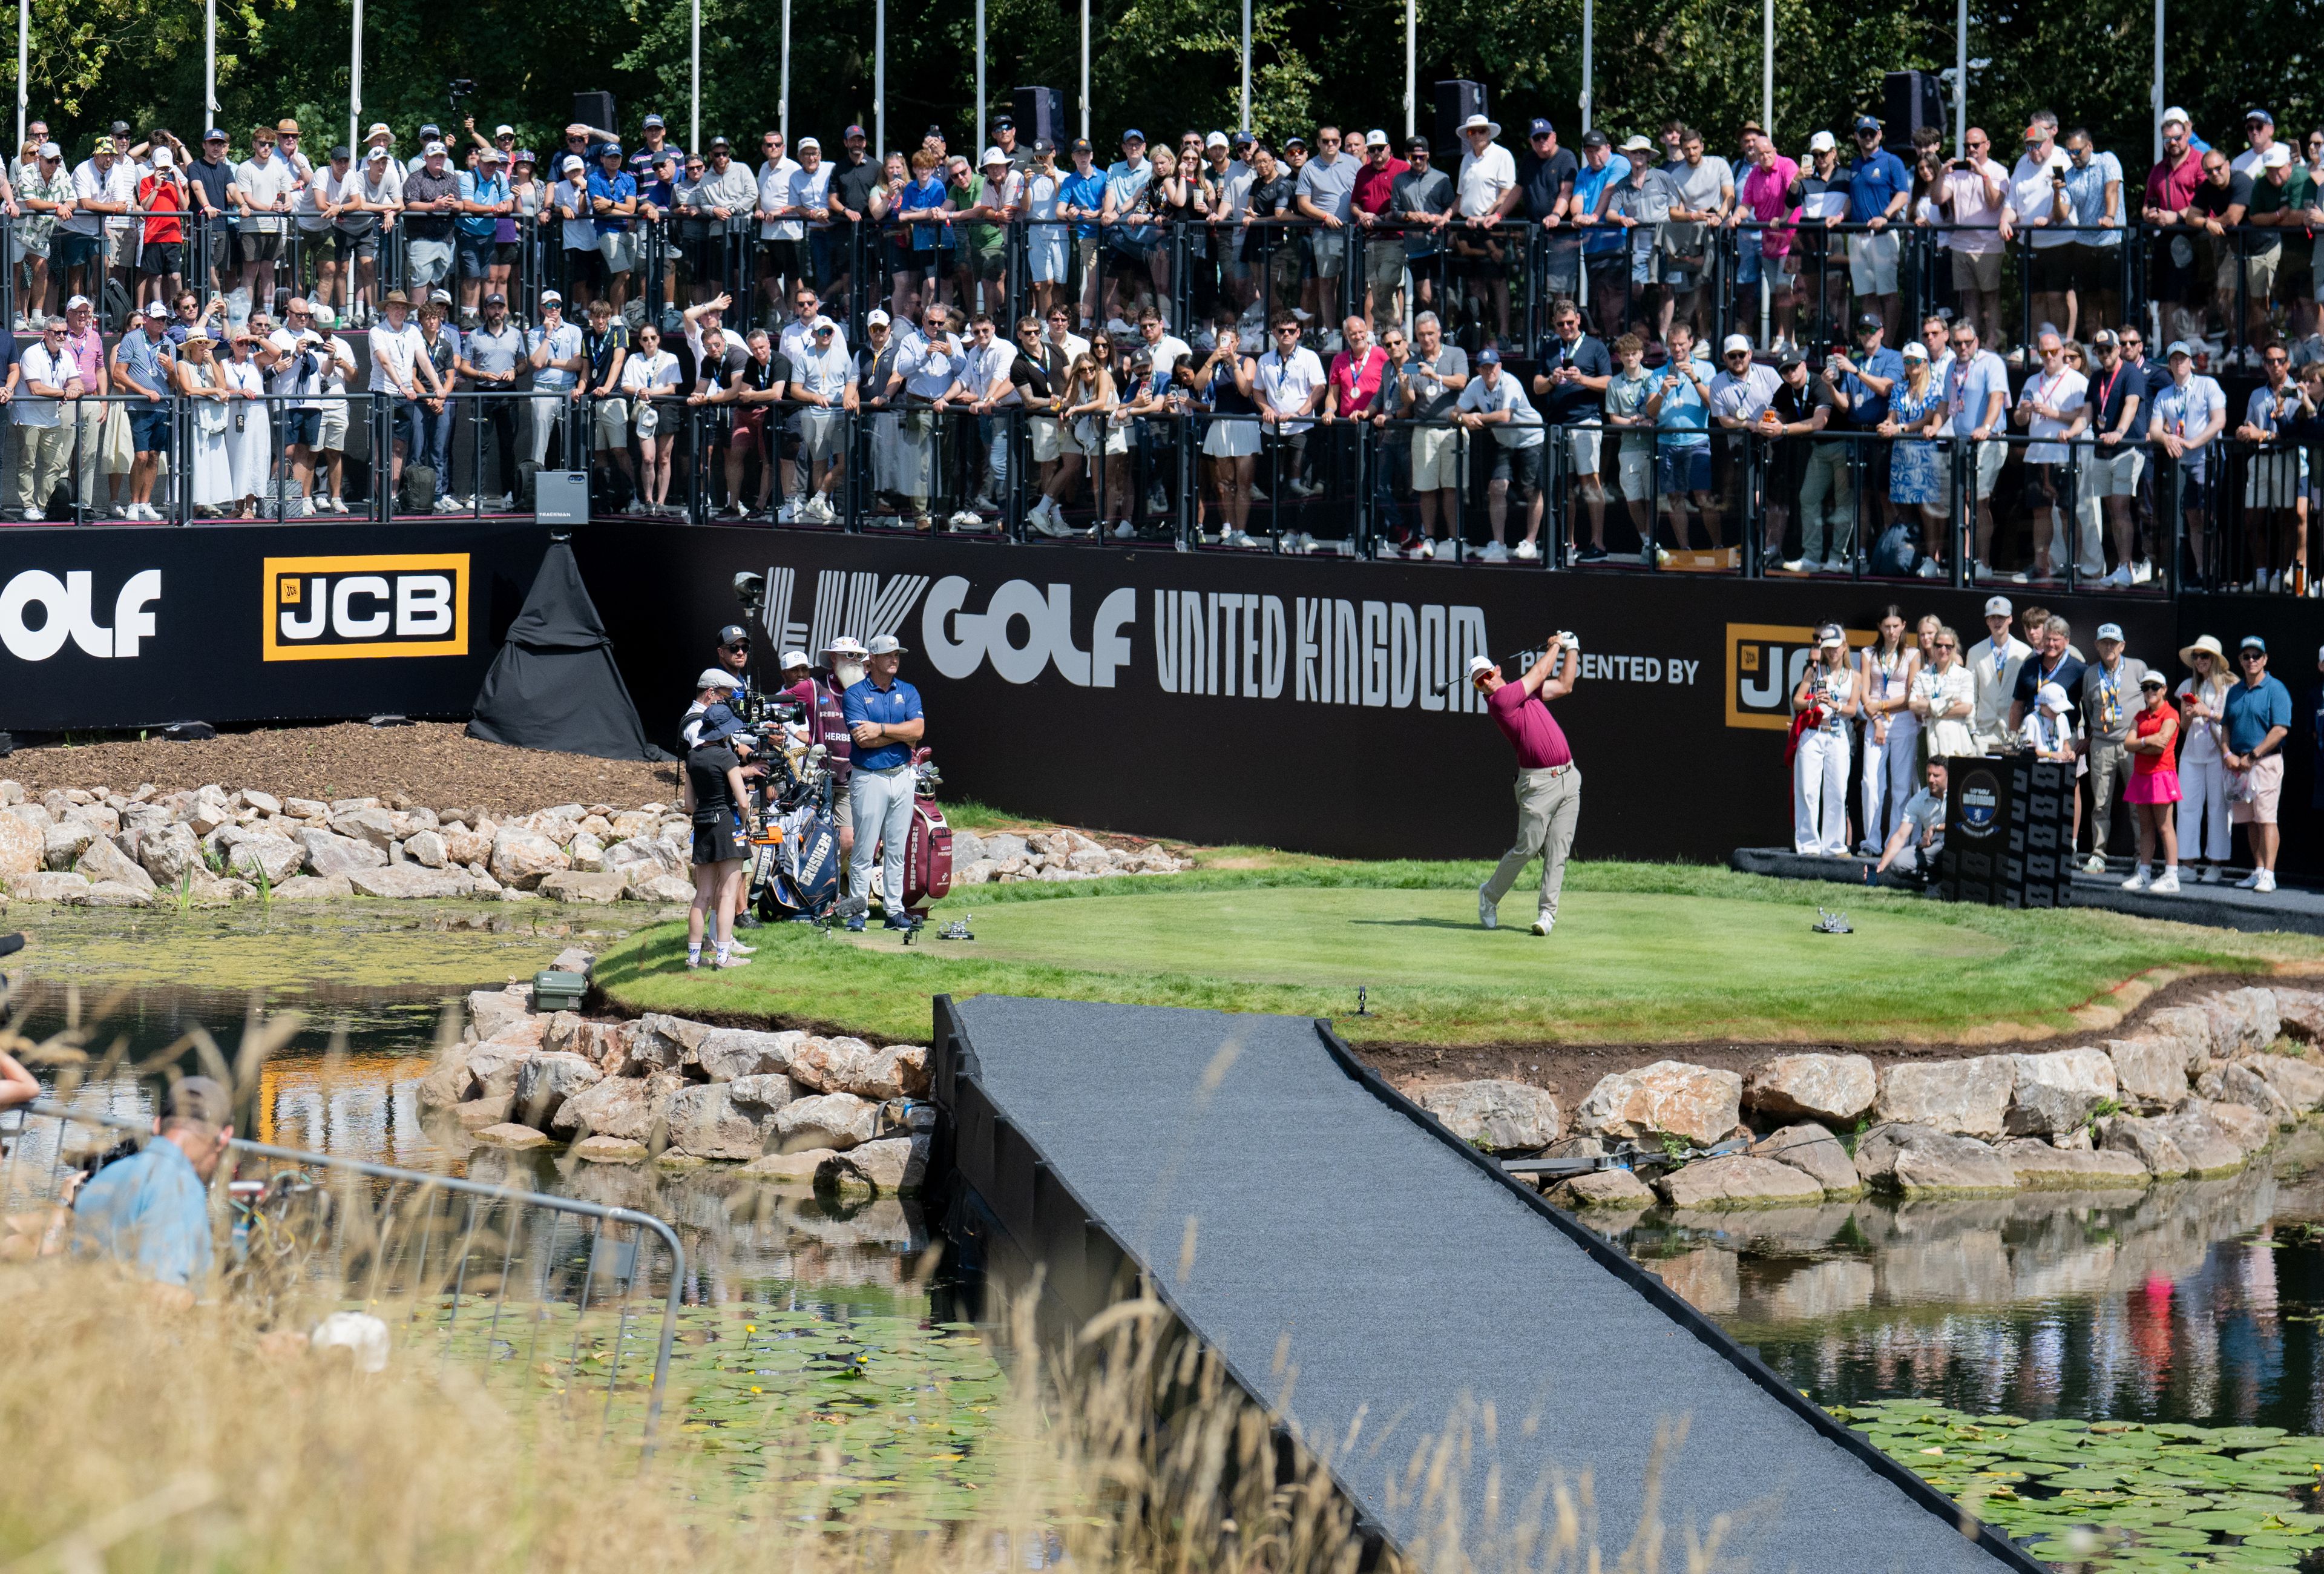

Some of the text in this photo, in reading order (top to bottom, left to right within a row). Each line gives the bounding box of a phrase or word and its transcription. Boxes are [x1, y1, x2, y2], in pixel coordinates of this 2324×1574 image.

[0, 569, 161, 661] OLF
[281, 576, 452, 639] JCB
[286, 585, 297, 597] JCB
[922, 576, 1135, 688] GOLF
[1155, 589, 1287, 700] UNITED
[1296, 597, 1489, 714] KINGDOM
[1668, 659, 1699, 686] BY
[825, 731, 851, 742] HERBE
[755, 847, 772, 886] CRUSHERS
[799, 832, 833, 887] CRUSHERS
[910, 826, 919, 891] RIPPERS
